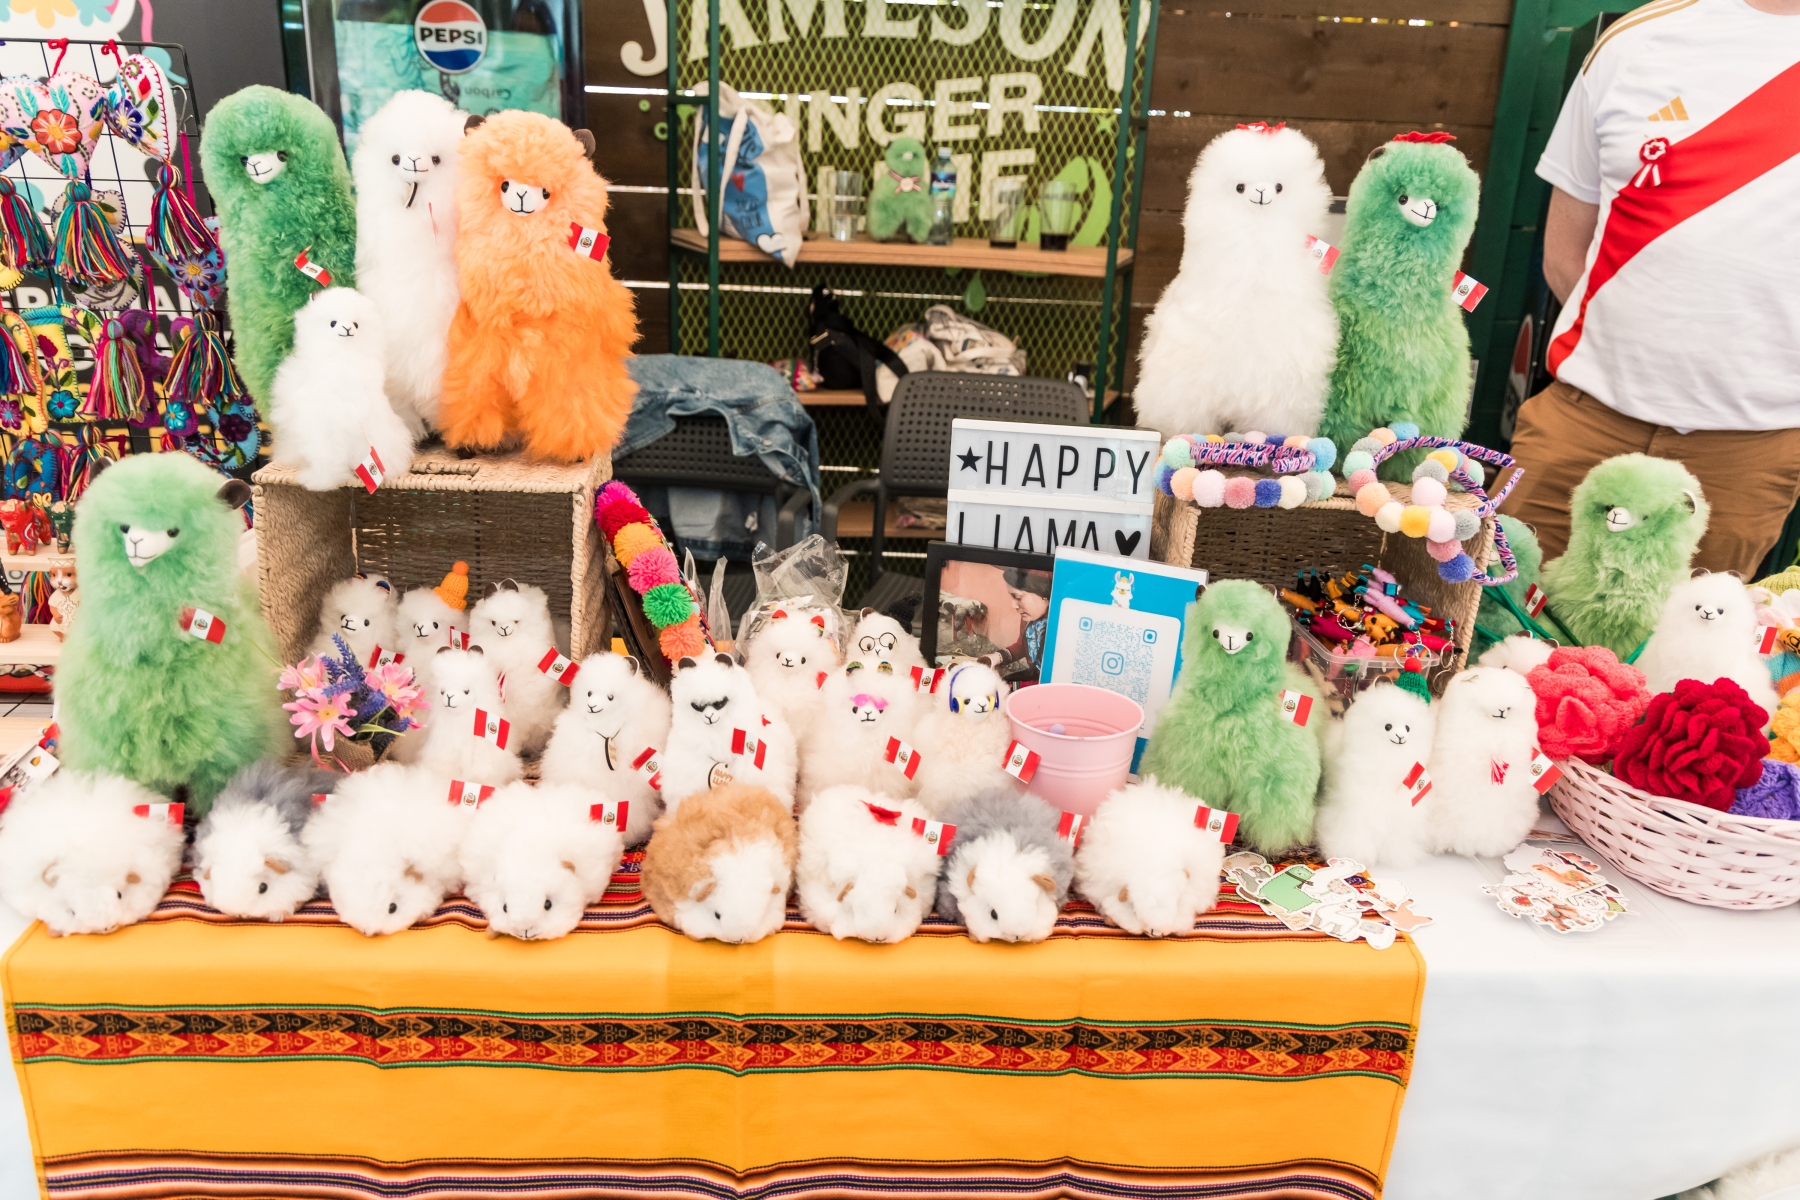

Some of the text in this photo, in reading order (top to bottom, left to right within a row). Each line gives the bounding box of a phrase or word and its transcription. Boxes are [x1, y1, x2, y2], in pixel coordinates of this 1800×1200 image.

[420, 27, 482, 45] PEPSI
[465, 86, 512, 100] Carbon
[758, 71, 1043, 153] INGER
[985, 440, 1150, 495] HAPPY
